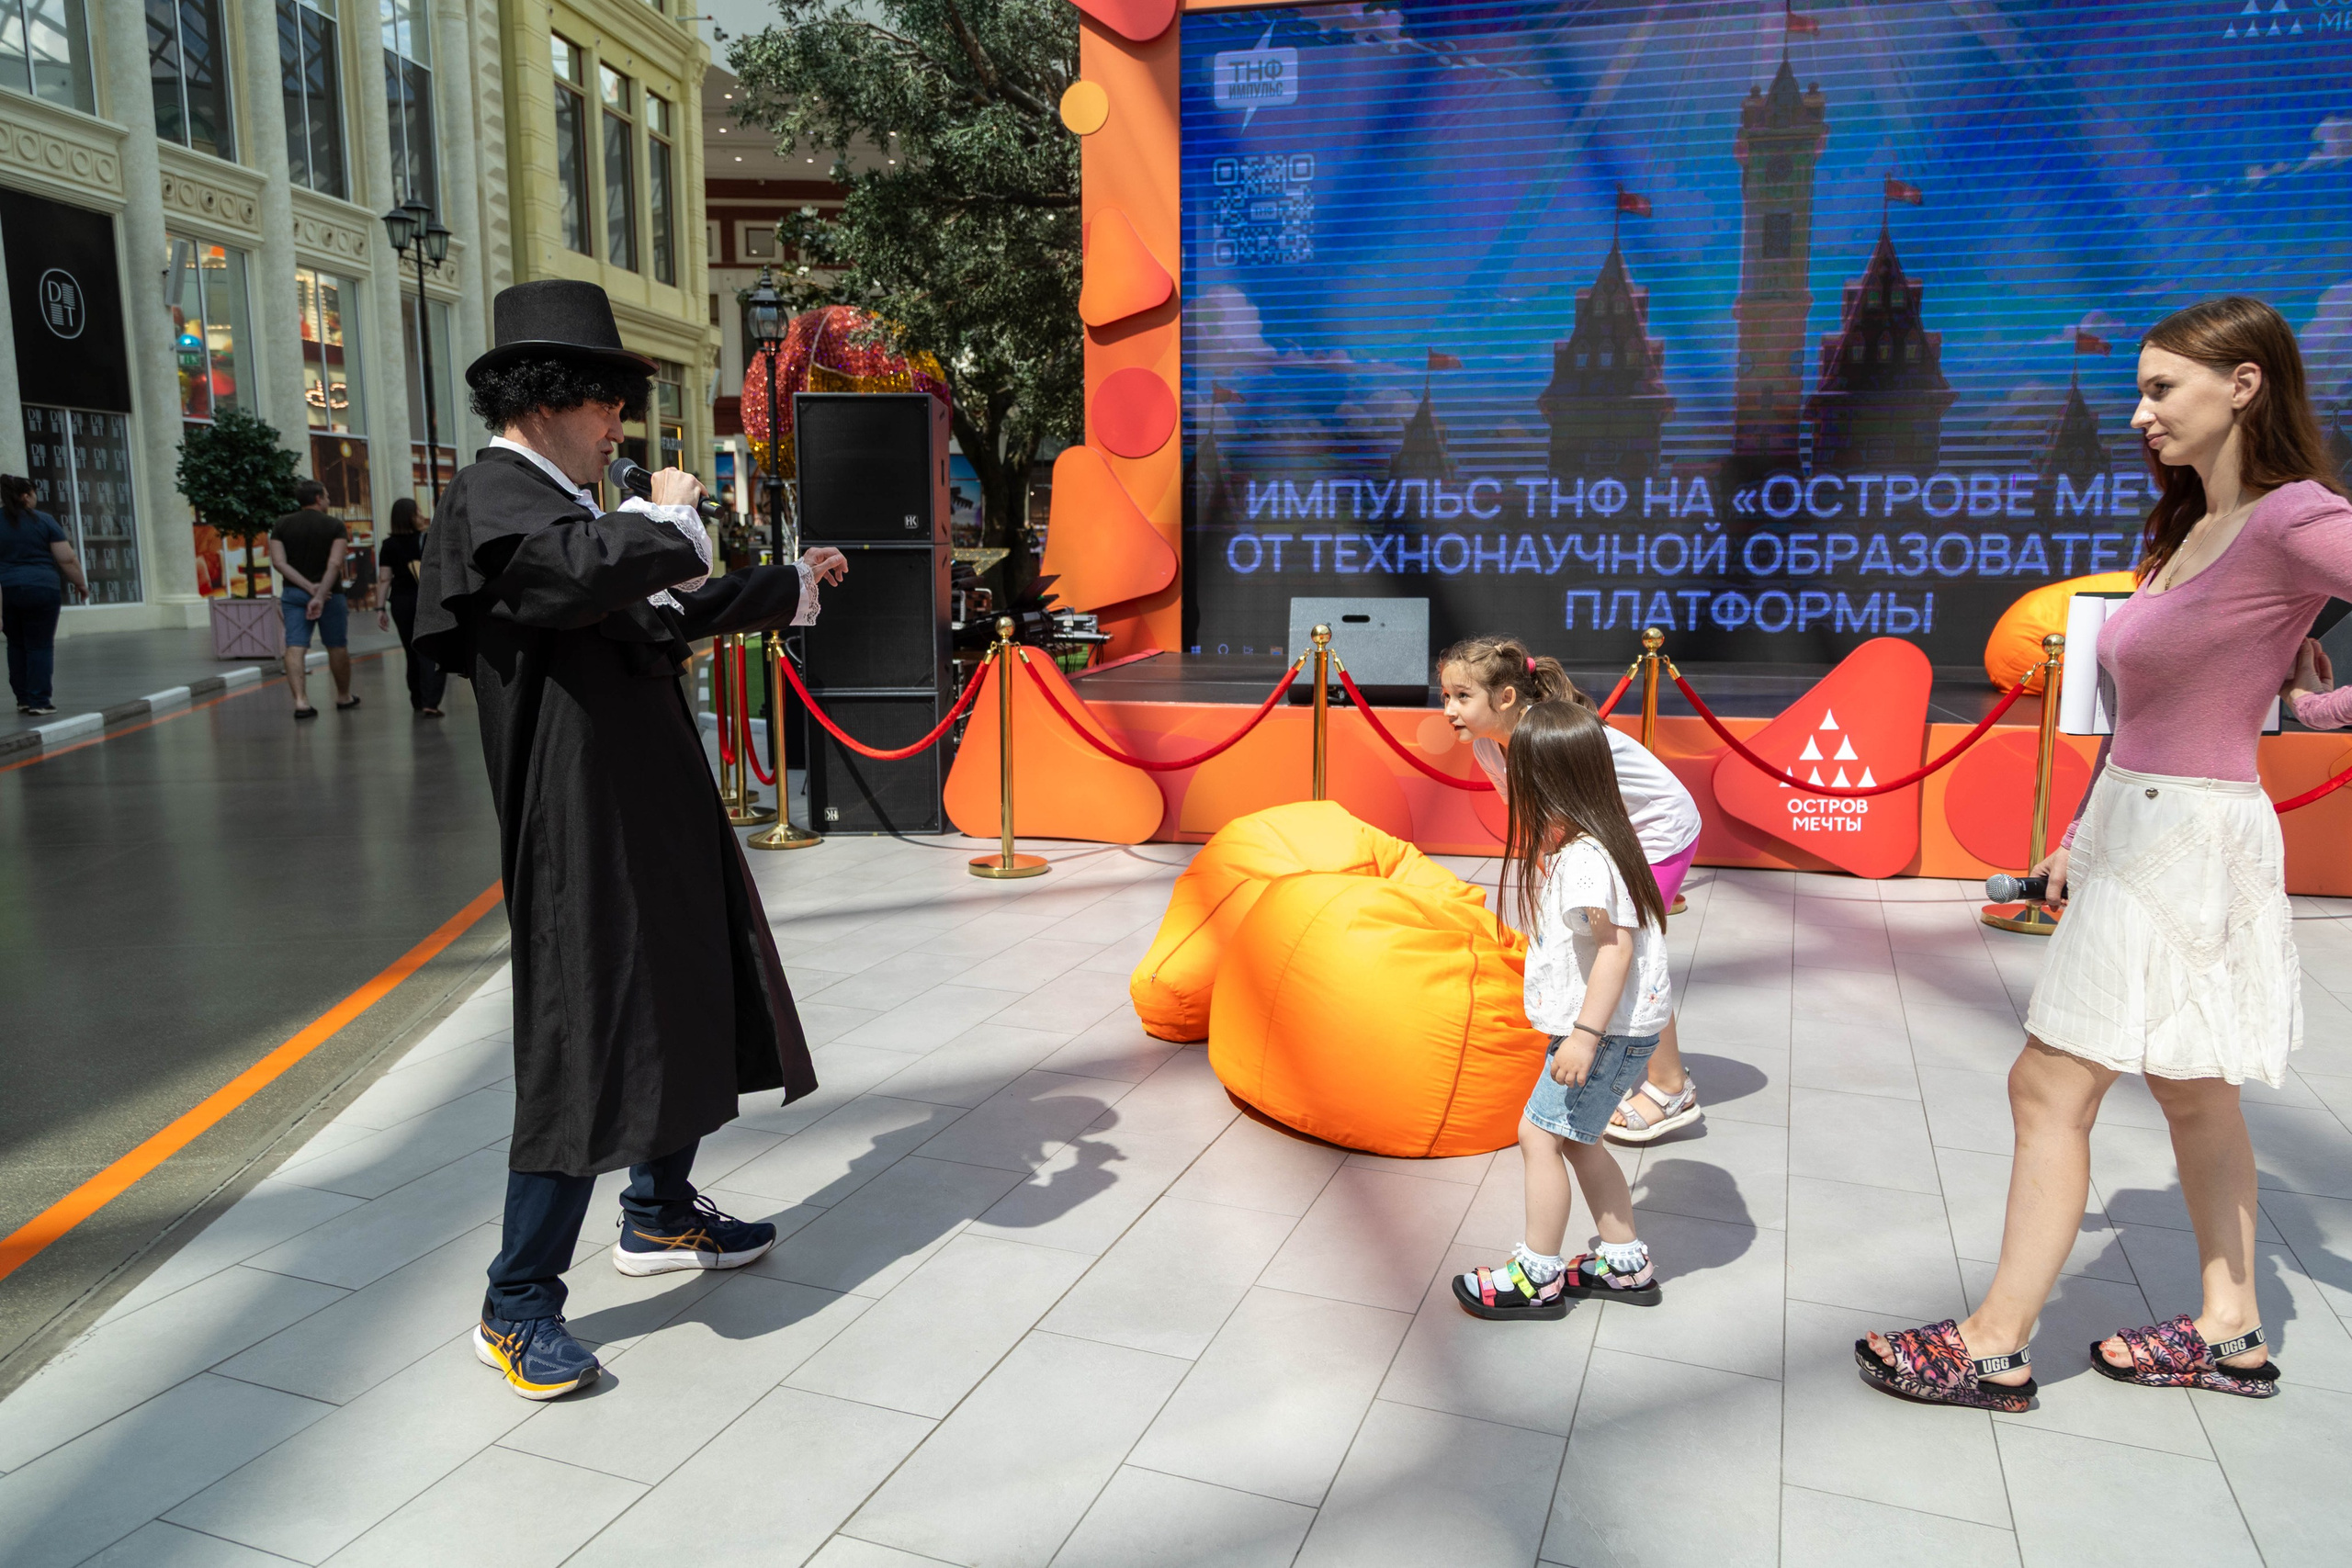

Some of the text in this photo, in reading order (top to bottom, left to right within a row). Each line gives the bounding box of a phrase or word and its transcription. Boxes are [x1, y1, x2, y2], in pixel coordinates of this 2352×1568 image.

[1228, 60, 1283, 82] ТНФ
[1228, 82, 1283, 100] ИМПУЛЬС
[1247, 477, 1501, 520] ИМПУЛЬС
[1516, 476, 1627, 518] ТНФ
[1644, 476, 1714, 518] НА
[1733, 473, 2034, 518] «ОСТРОВЕ
[1227, 533, 1295, 574] ОТ
[1301, 523, 1727, 576] ТЕХНОНАУЧНОЙ
[1566, 589, 1934, 634] ПЛАТФОРМЫ
[1787, 798, 1869, 814] ОСТРОВ
[1792, 816, 1862, 832] МЕЧТЫ
[2220, 1337, 2247, 1356] UGG
[1982, 1357, 2010, 1373] UGG
